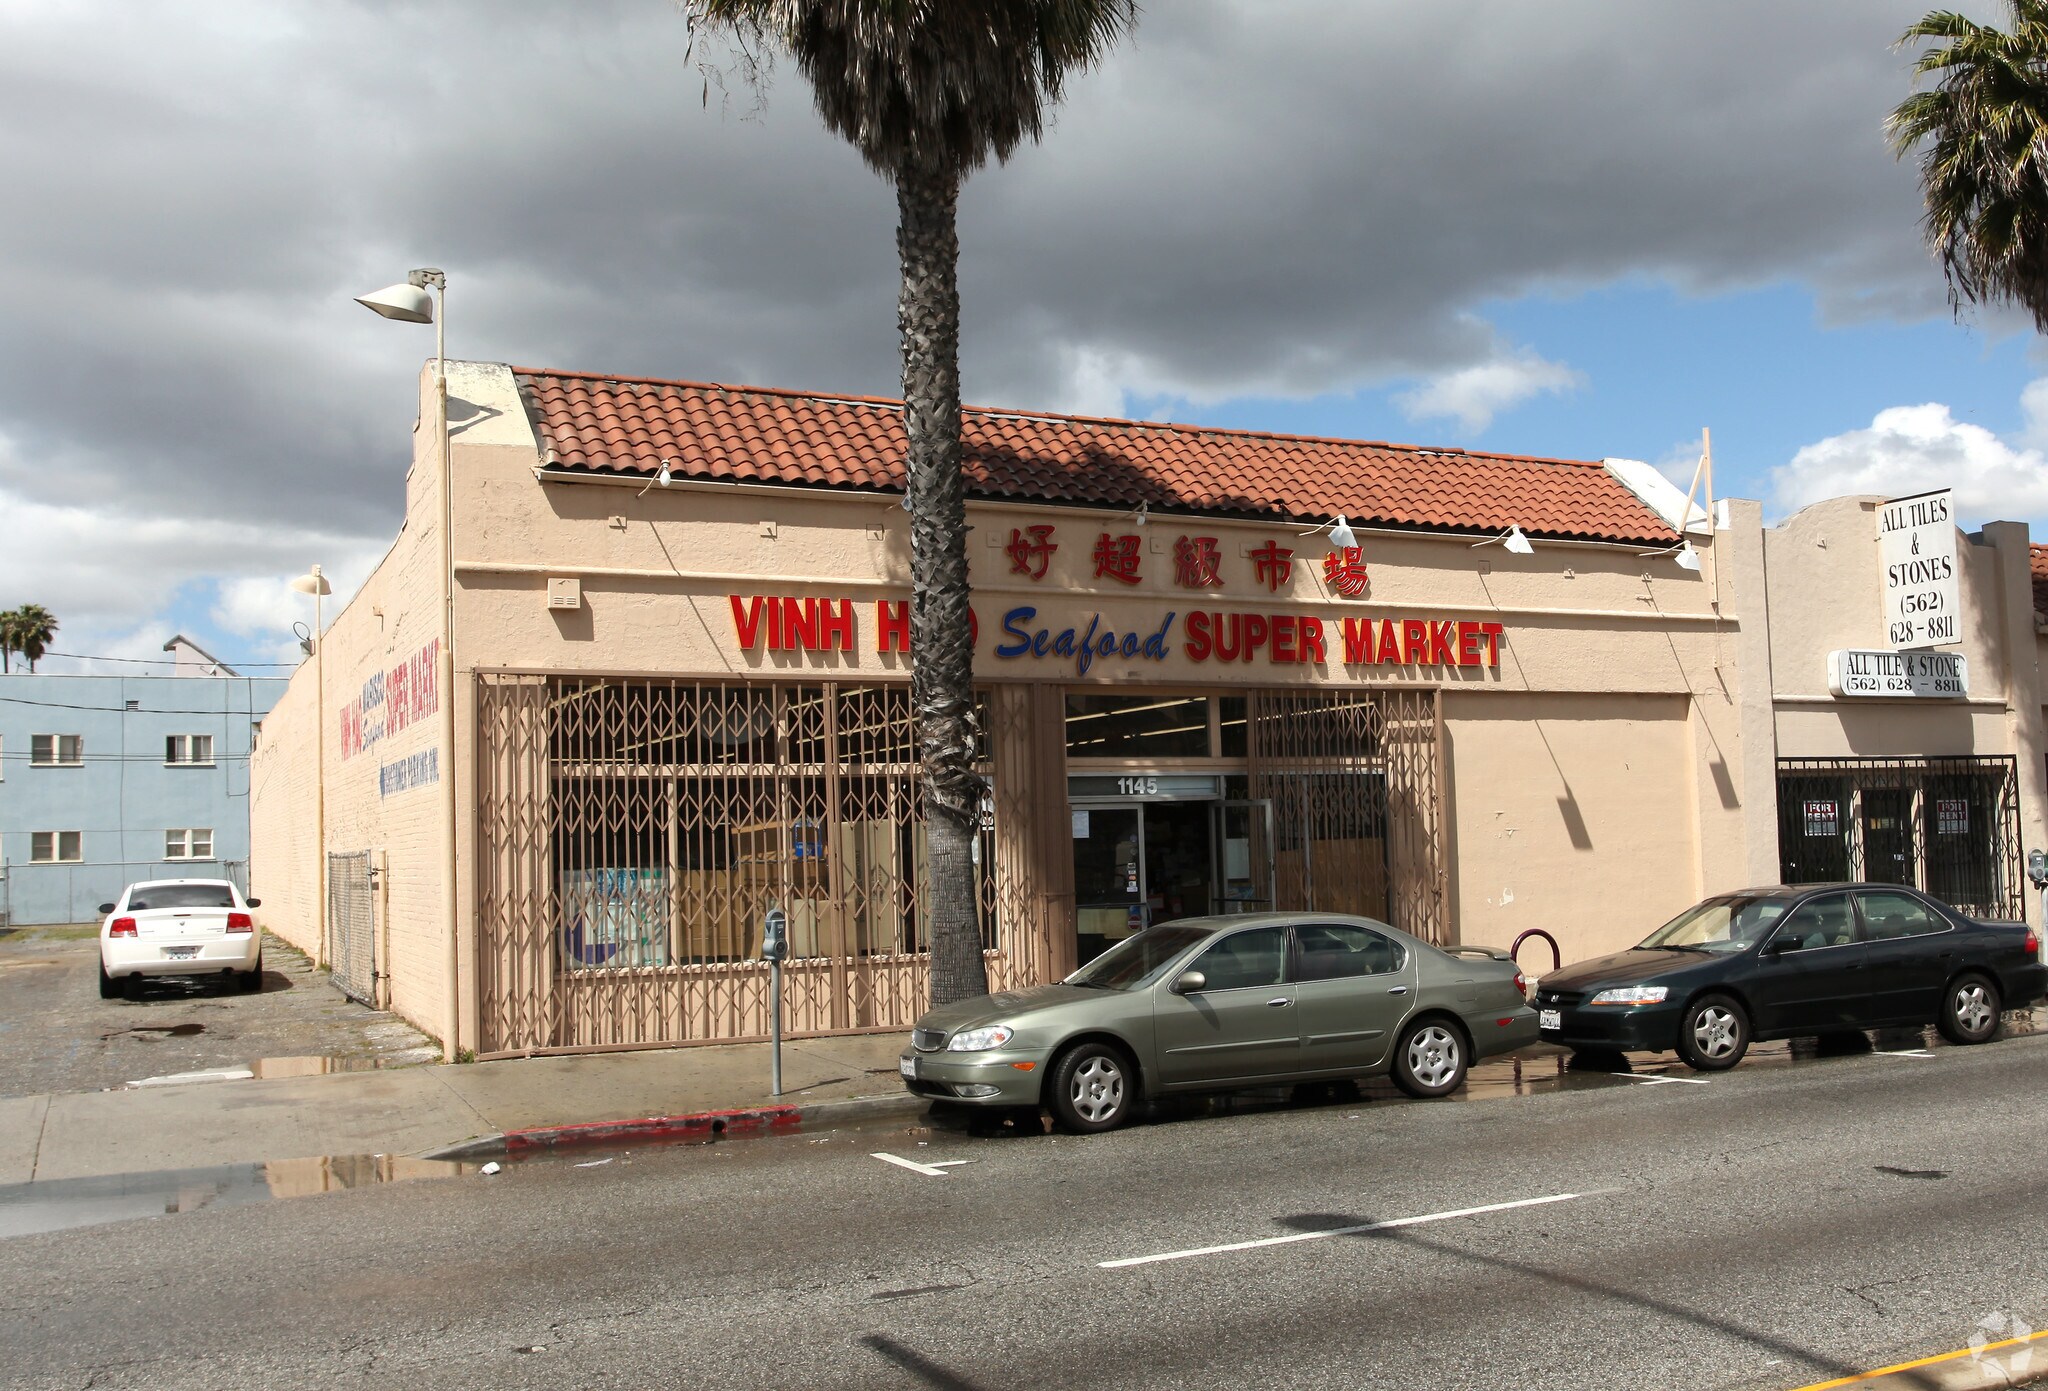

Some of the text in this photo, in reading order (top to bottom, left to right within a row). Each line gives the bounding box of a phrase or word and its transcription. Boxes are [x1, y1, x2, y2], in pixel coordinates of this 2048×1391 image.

[1882, 497, 1948, 534] ALL TILES
[1911, 531, 1920, 556] &
[1889, 555, 1952, 588] STONES
[1900, 590, 1944, 618] (562)
[728, 594, 853, 652] VINH
[995, 606, 1176, 676] Seafood
[1184, 610, 1325, 664] SUPER
[1341, 616, 1504, 668] MARKET
[1846, 654, 1961, 678] ALL TILE & STONE
[1846, 677, 1881, 693] (562)
[386, 661, 409, 740] SUPER
[1117, 777, 1158, 795] 1145
[1807, 812, 1835, 822] RENT
[1809, 803, 1832, 812] FOR
[1939, 811, 1965, 820] RENT
